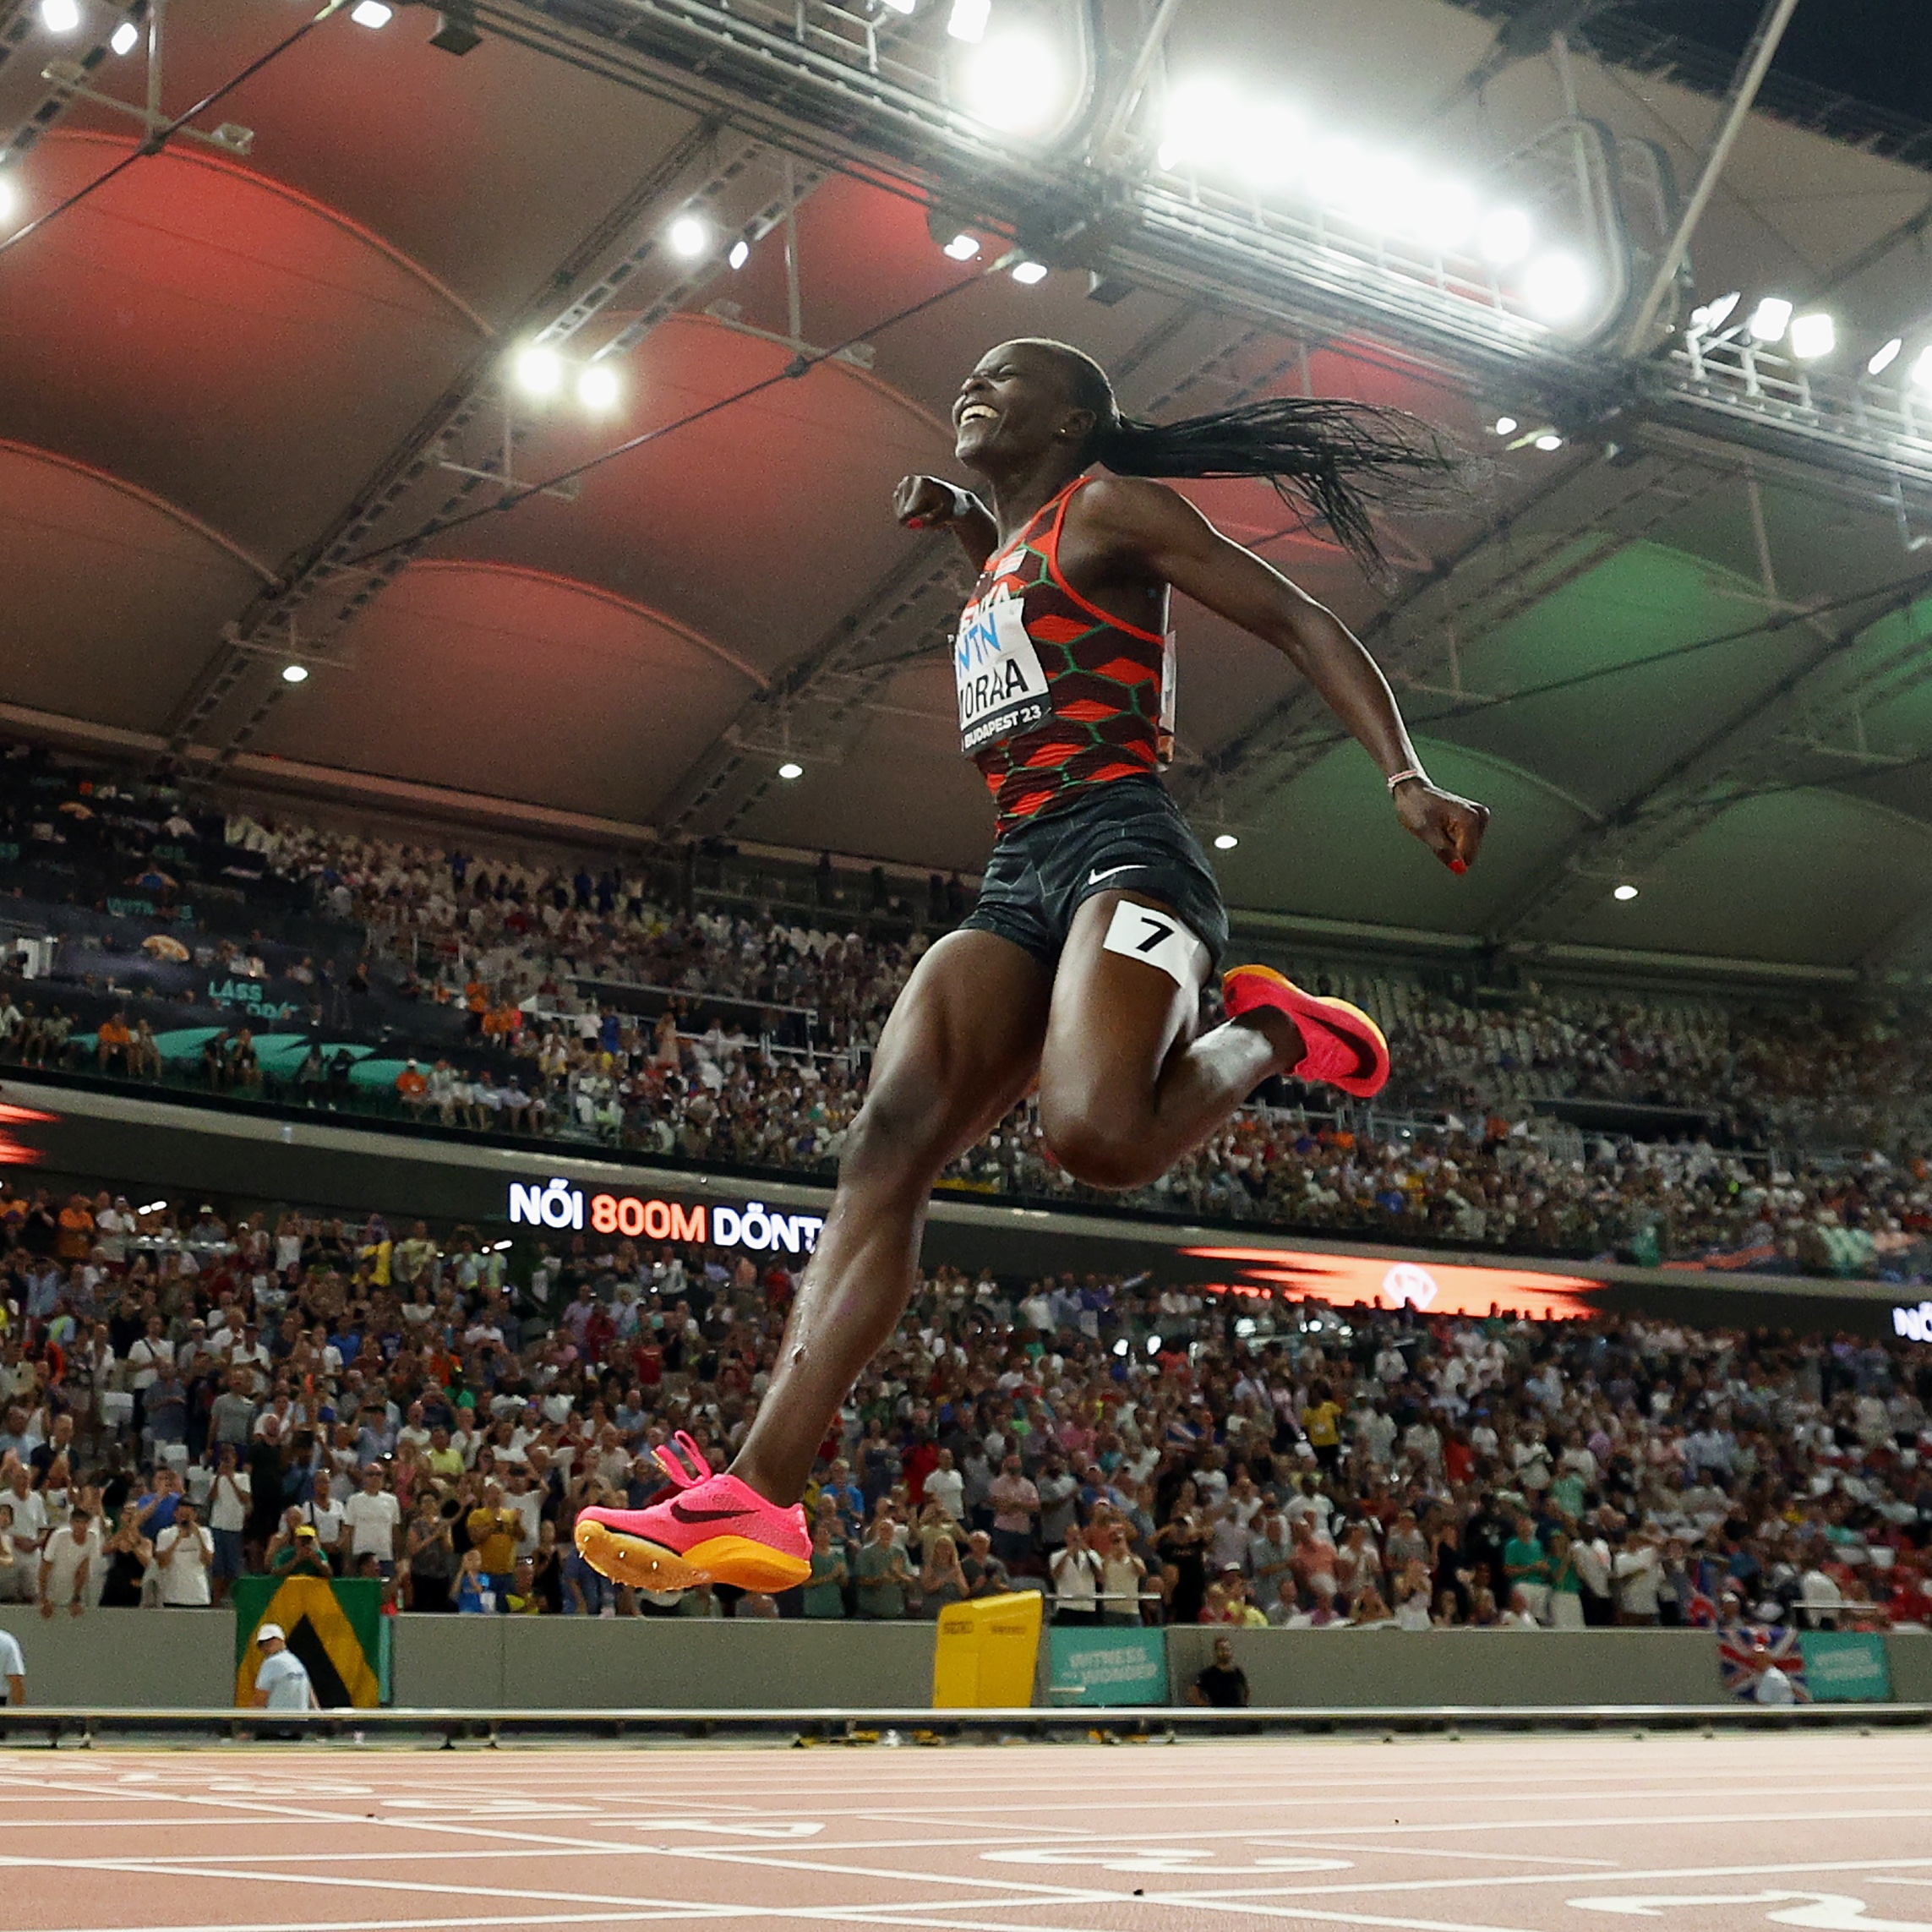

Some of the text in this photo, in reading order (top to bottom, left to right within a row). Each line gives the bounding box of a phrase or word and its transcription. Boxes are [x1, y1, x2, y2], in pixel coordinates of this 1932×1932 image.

[958, 612, 1001, 678] NTN
[964, 705, 1041, 749] BUDAPEST 23
[1136, 916, 1175, 953] 7
[592, 1193, 706, 1243] 800M
[712, 1202, 826, 1254] DÖNT
